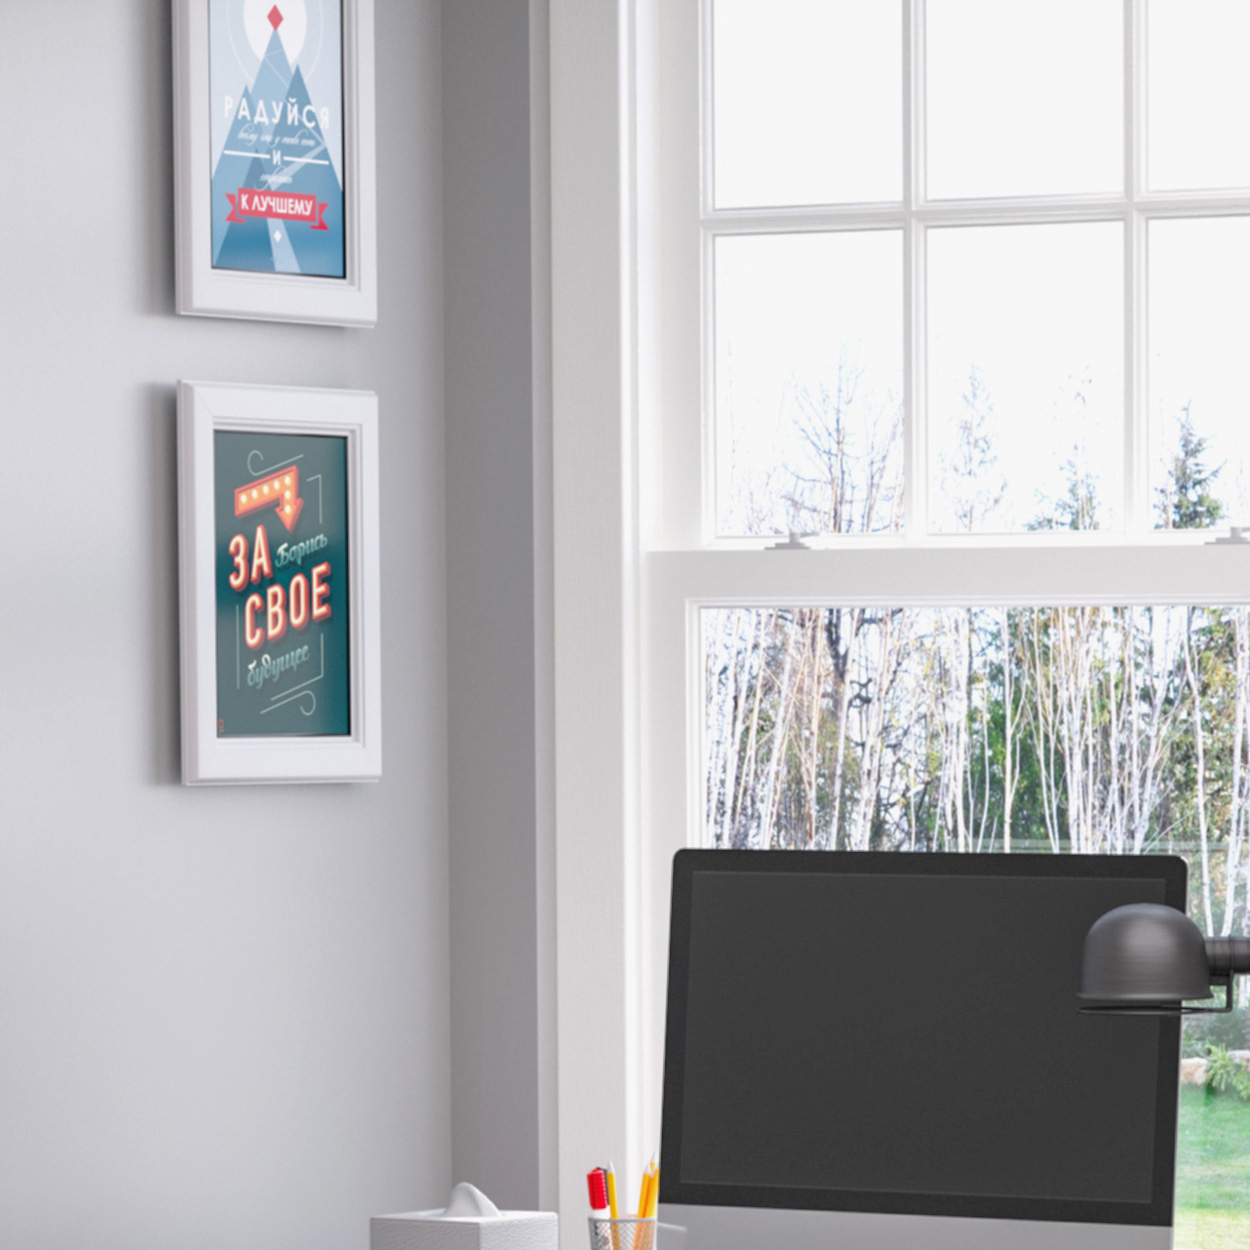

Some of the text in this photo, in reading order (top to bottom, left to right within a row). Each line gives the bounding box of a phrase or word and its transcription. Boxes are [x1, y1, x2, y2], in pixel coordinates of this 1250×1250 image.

[223, 95, 330, 129] РАДУЙСЯ
[272, 149, 282, 166] И
[241, 194, 314, 217] К ЛУЧШЕМУ
[228, 524, 273, 592] ЗА
[275, 533, 328, 567] Борись
[244, 561, 332, 652] СВОЕ
[247, 645, 311, 690] будущее
